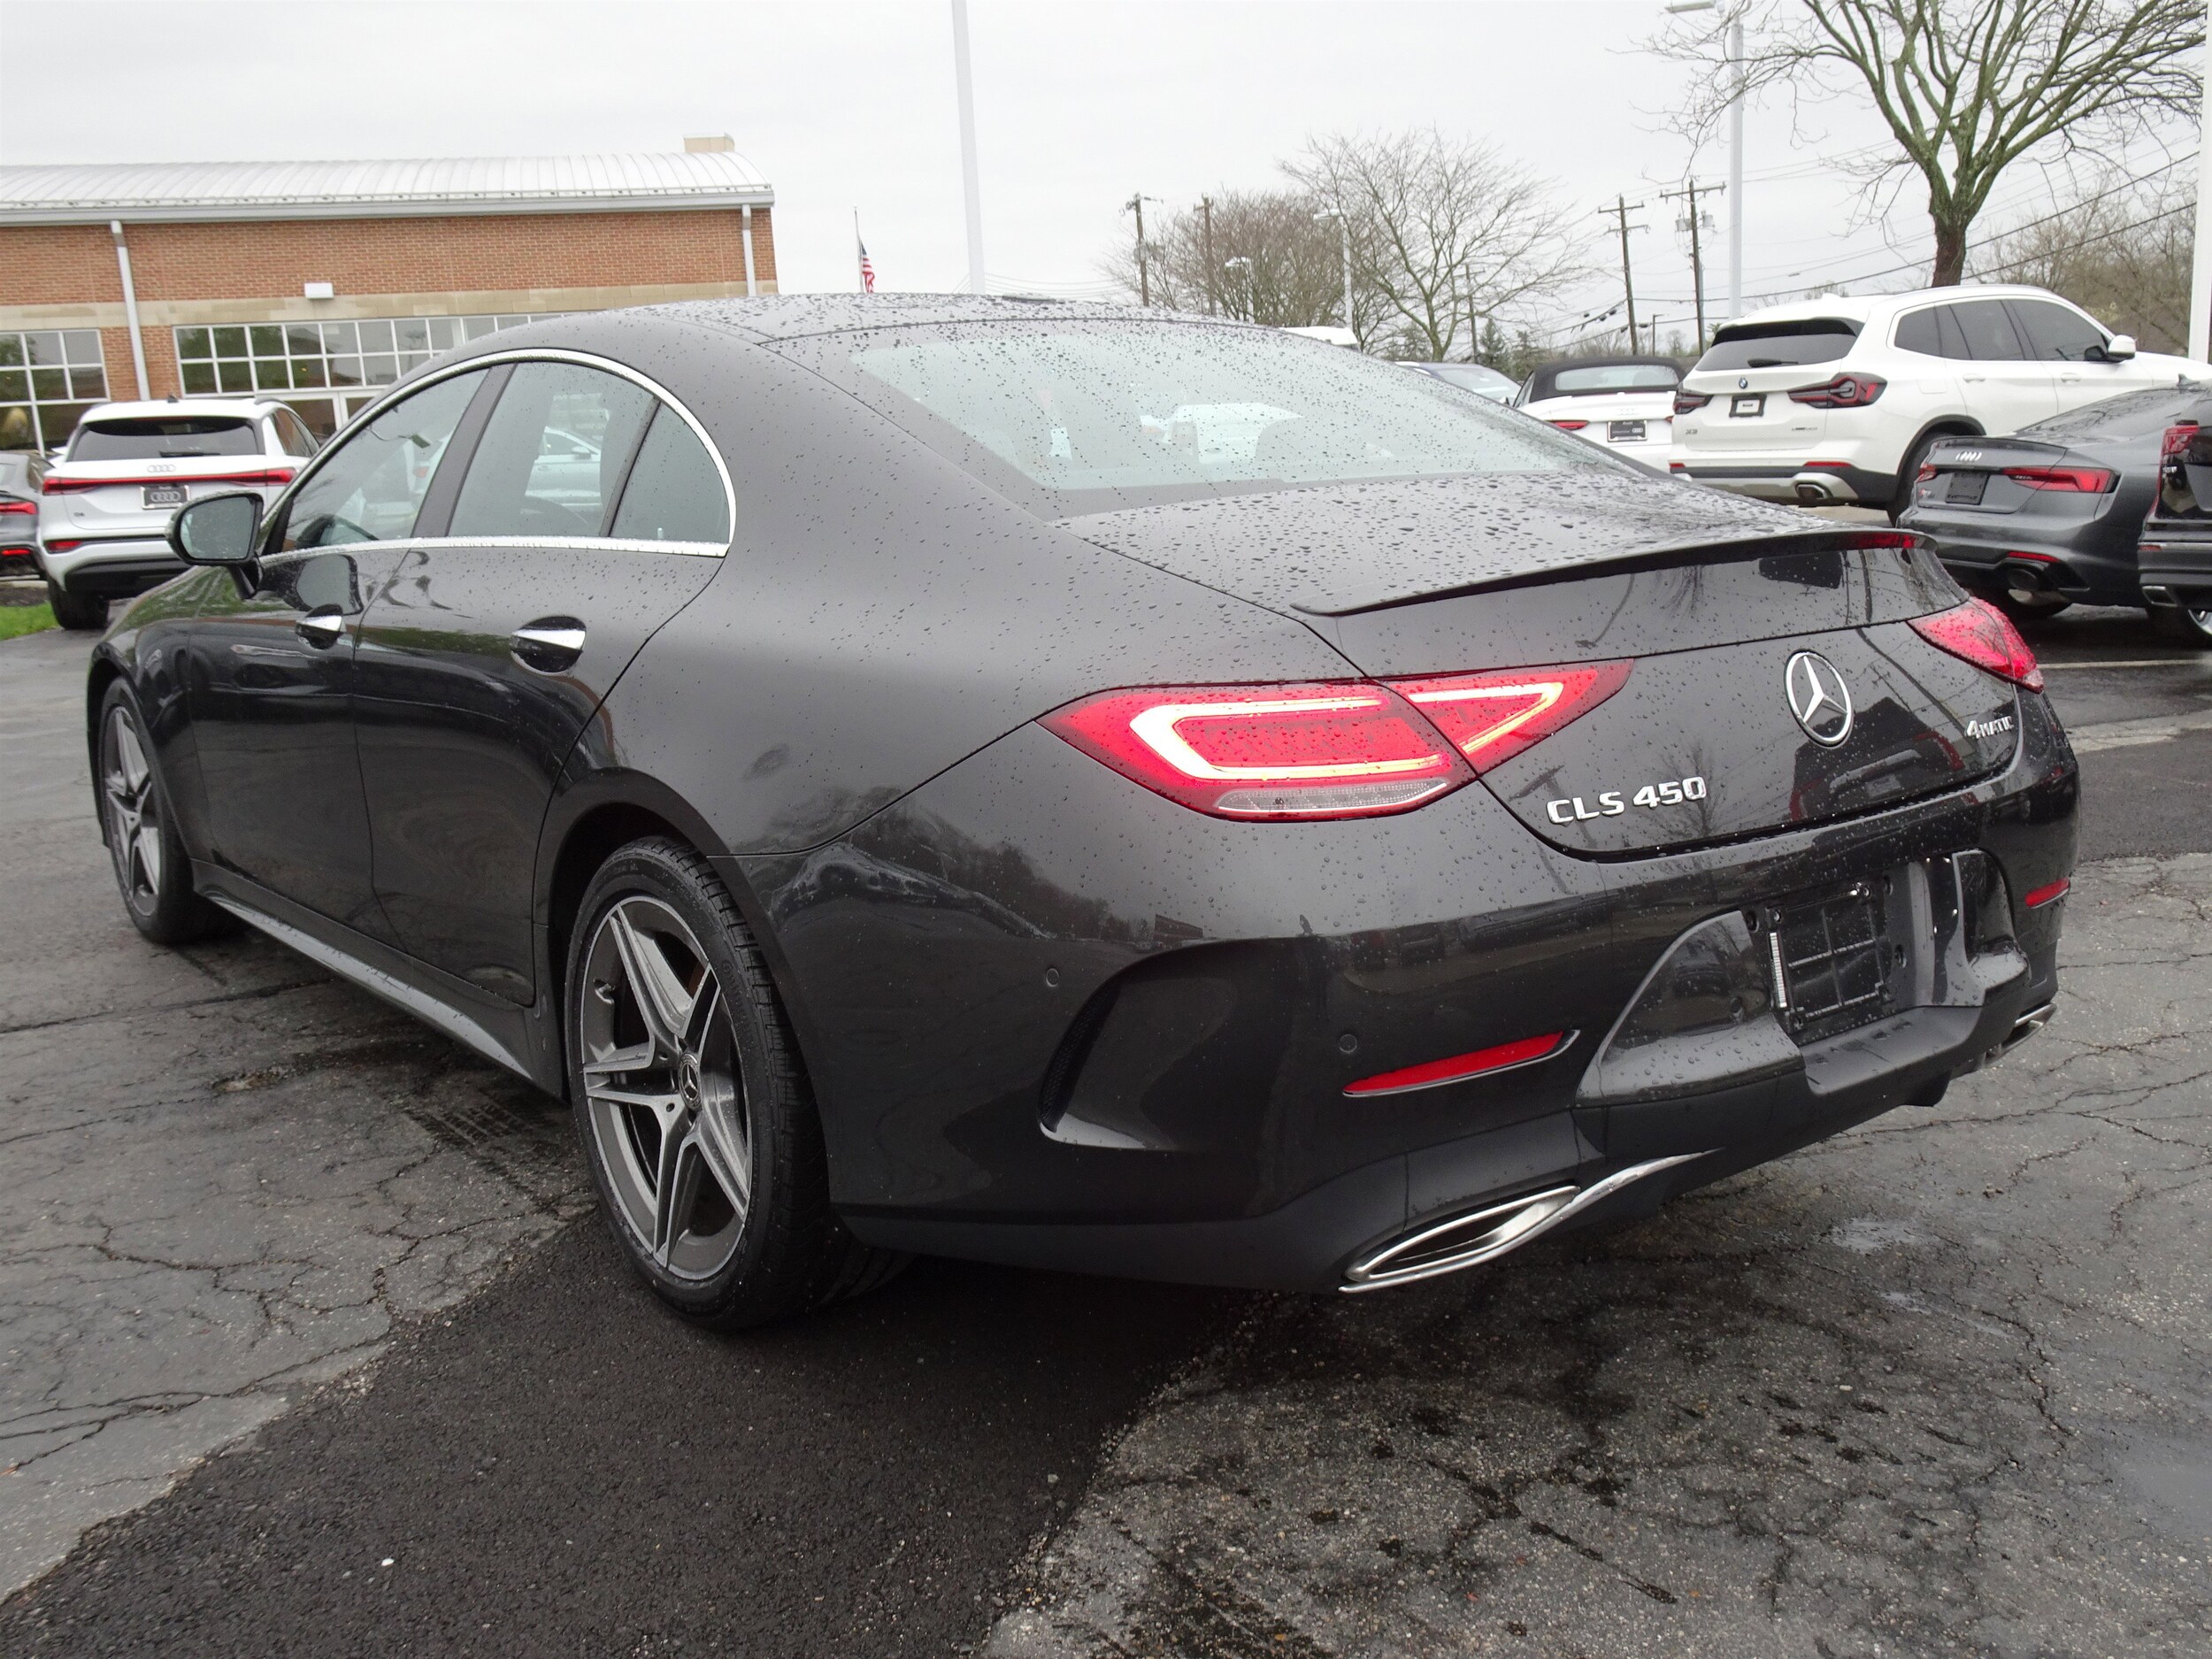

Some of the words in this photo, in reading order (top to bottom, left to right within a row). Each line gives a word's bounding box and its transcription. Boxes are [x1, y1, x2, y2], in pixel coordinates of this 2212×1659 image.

[1966, 716, 2015, 739] 4MATIC
[1547, 791, 1625, 825] CLS
[1632, 776, 1708, 809] 450
